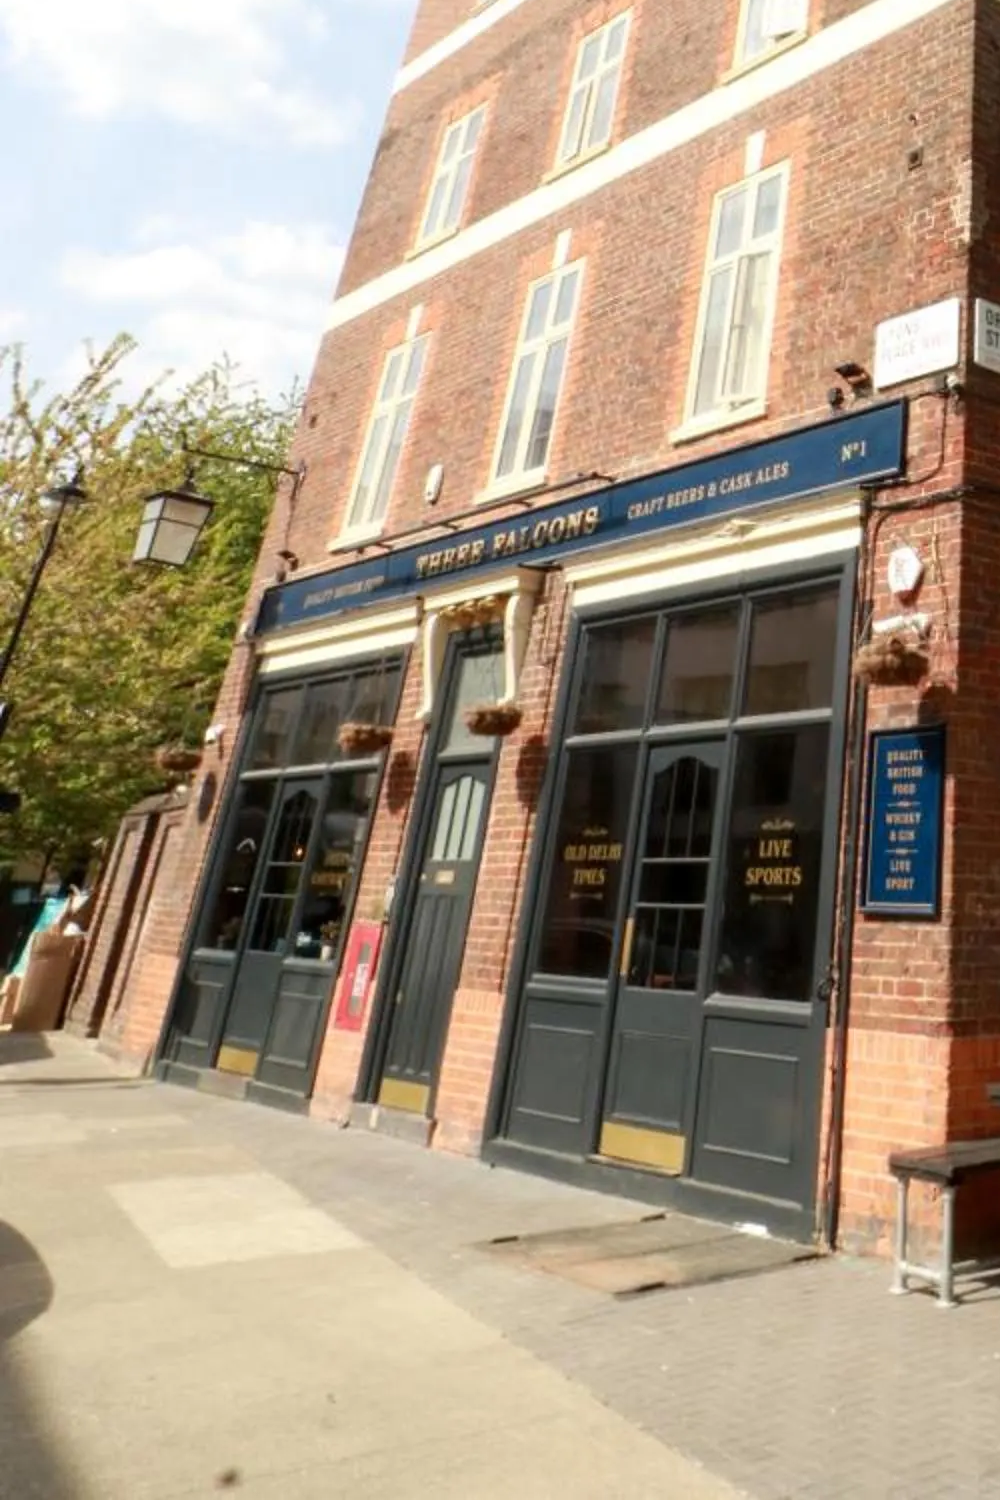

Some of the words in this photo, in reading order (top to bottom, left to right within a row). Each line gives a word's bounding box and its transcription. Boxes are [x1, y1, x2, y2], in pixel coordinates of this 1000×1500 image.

[627, 499, 664, 521] CRAFT
[666, 484, 705, 510] BEERS
[708, 481, 718, 498] &
[719, 472, 752, 495] CASK
[755, 461, 790, 486] ALES
[415, 538, 486, 579] THREE
[492, 505, 600, 559] FALCONS
[758, 838, 792, 859] LIVE
[745, 866, 803, 886] SPORTS
